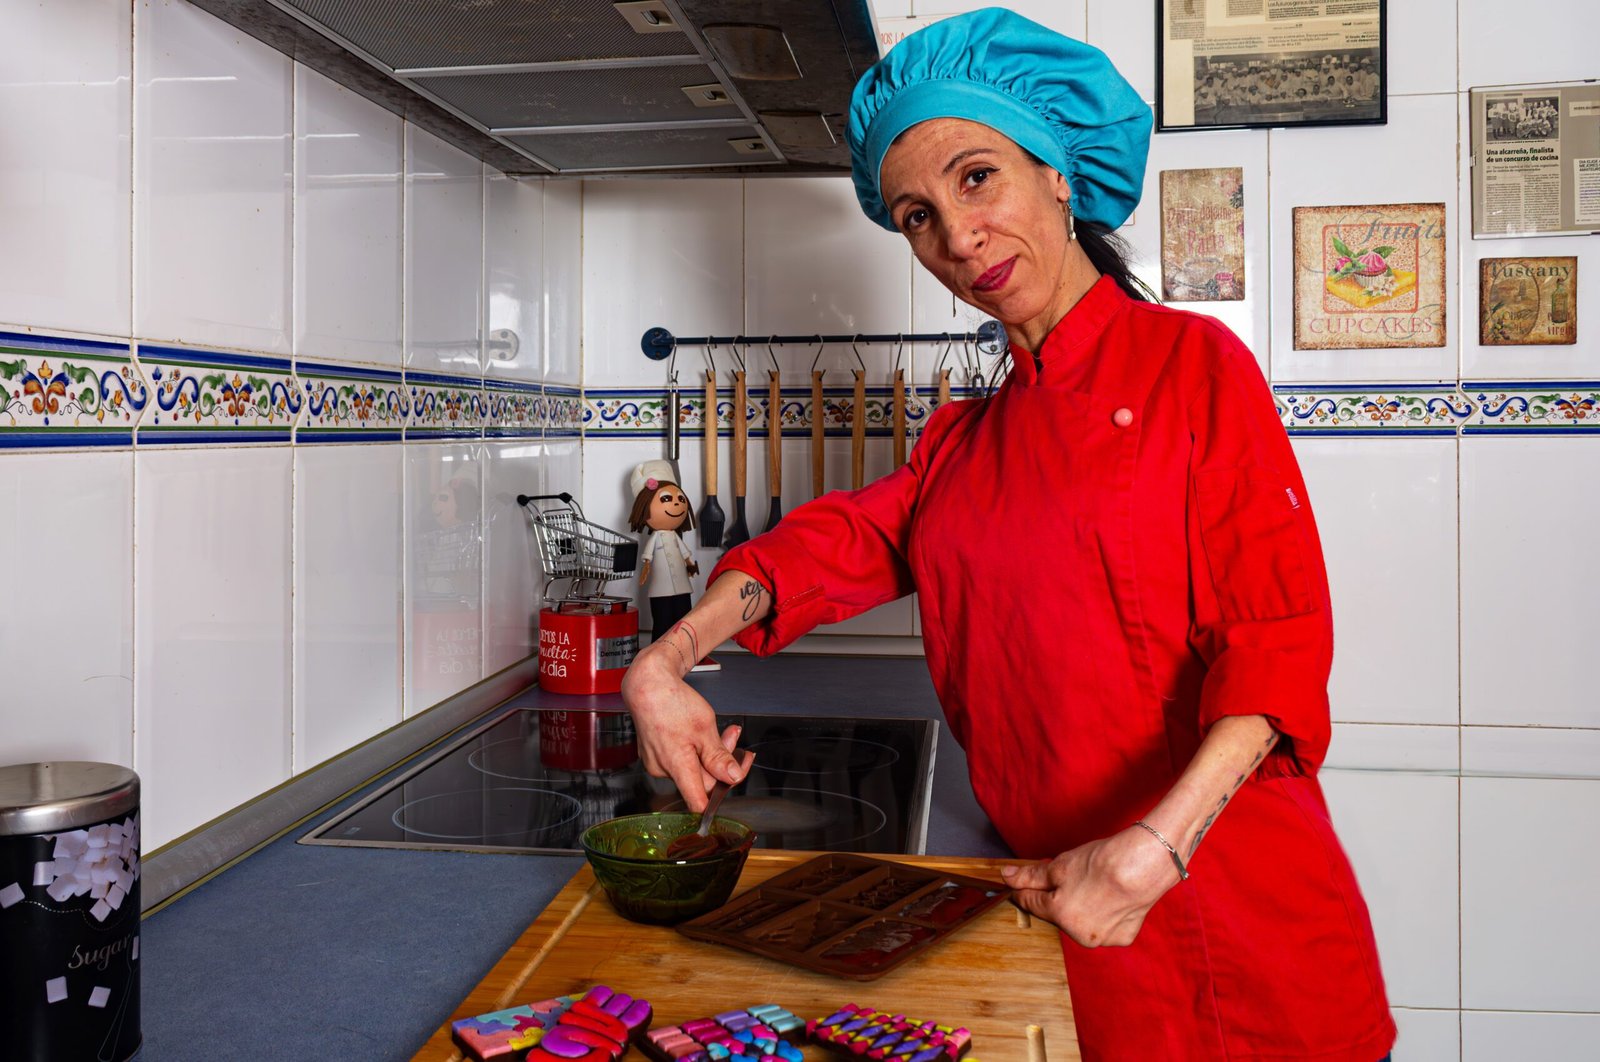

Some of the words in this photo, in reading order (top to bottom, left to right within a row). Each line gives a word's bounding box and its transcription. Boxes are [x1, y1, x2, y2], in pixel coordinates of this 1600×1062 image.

[1489, 262, 1573, 281] Tuscany
[1308, 316, 1433, 334] CUPCAKES
[559, 632, 570, 646] LA
[547, 660, 567, 678] día
[68, 934, 130, 971] Sugar
